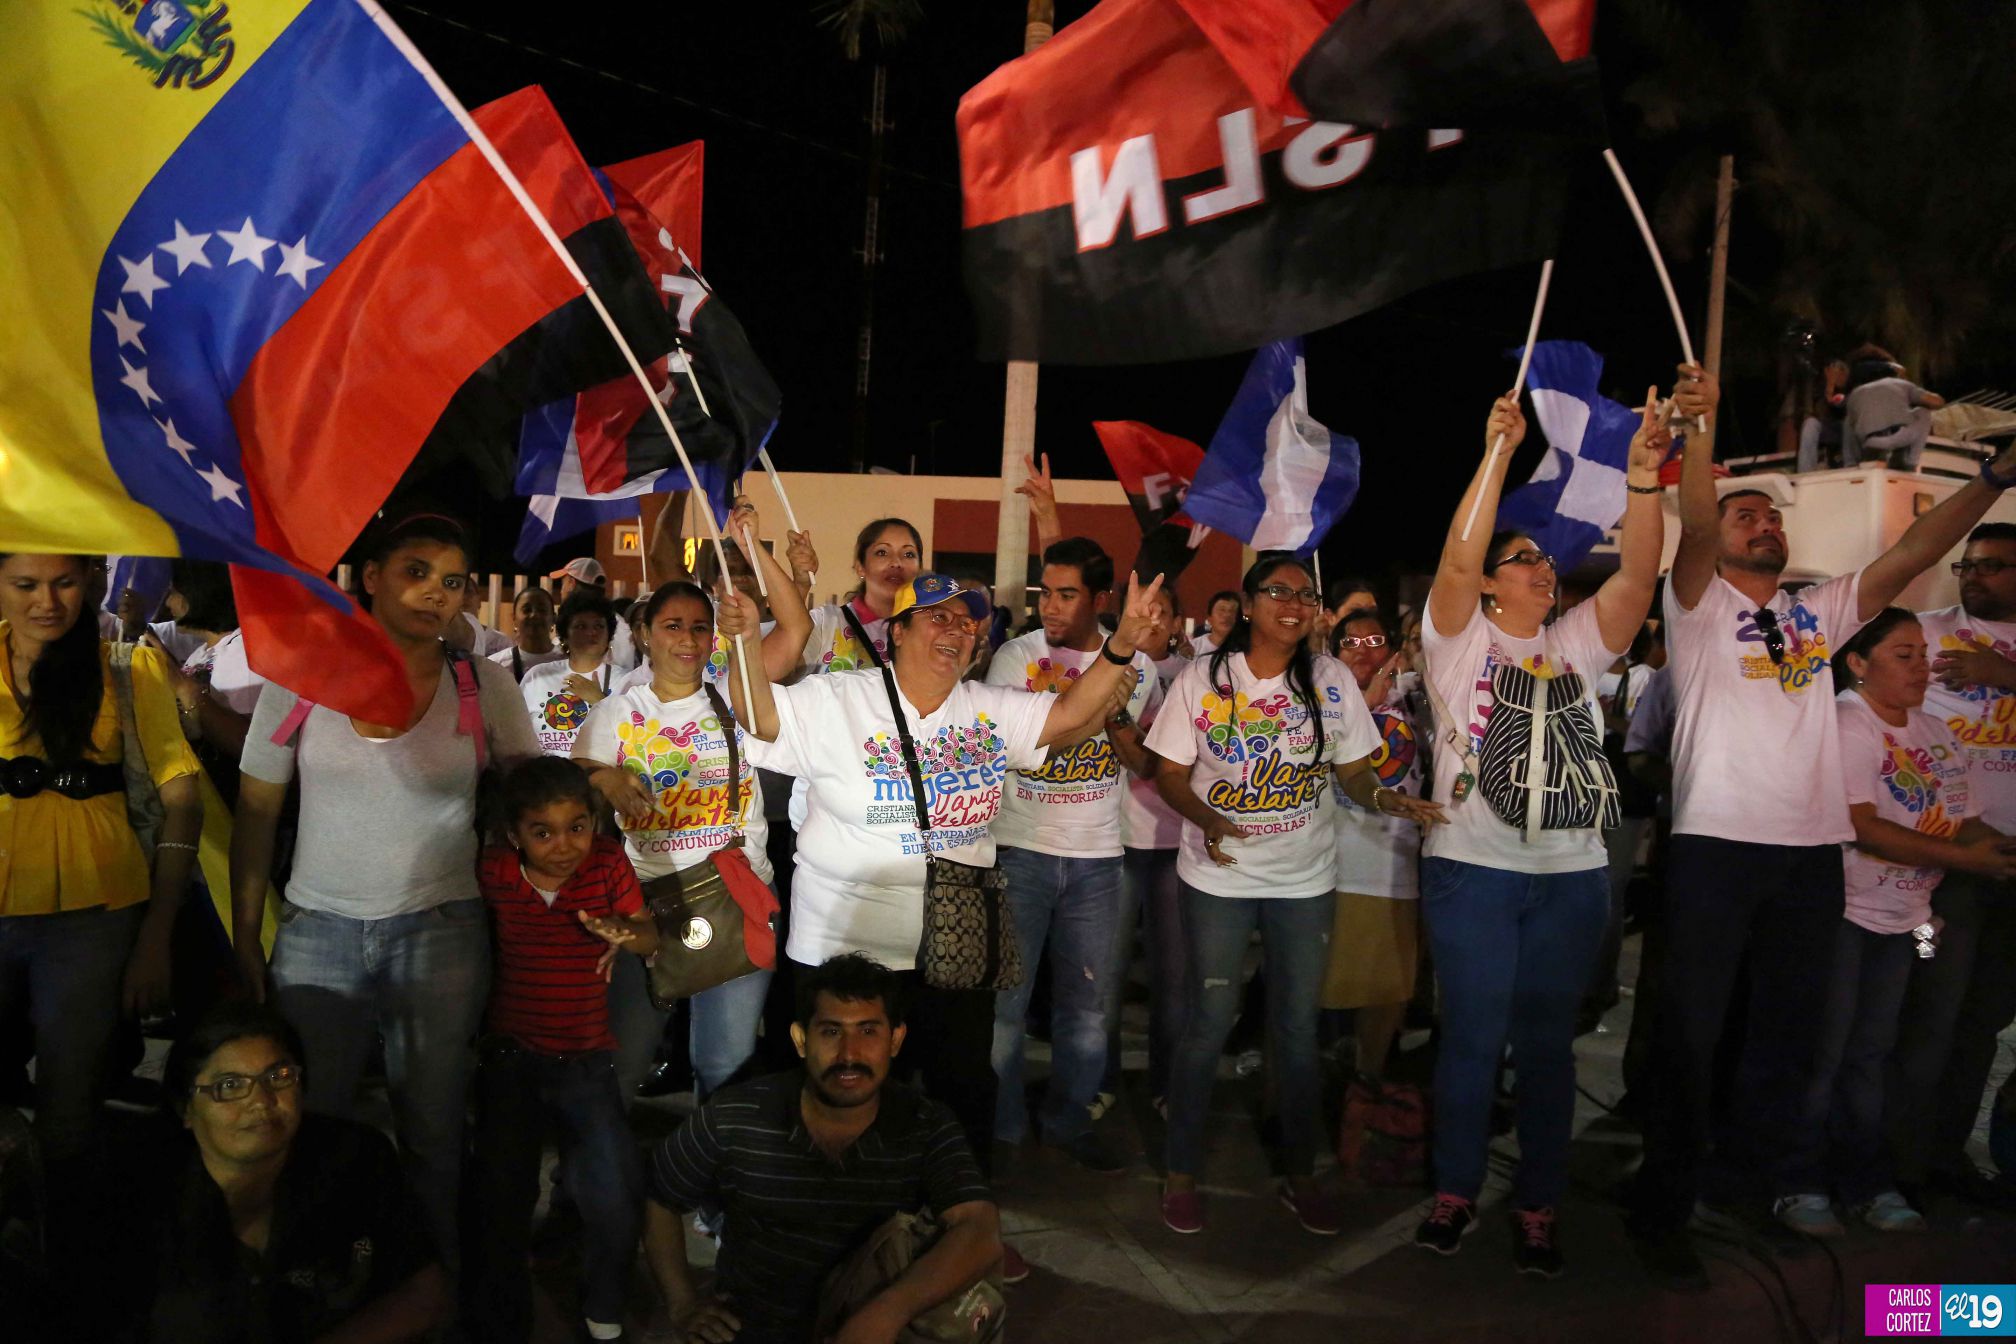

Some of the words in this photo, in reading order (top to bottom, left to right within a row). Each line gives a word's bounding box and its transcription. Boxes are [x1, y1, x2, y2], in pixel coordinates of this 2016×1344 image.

[692, 733, 708, 743] EN
[1016, 787, 1033, 801] EN
[1037, 787, 1111, 804] VICTORIAS!
[867, 804, 916, 812] CRISTIANA
[1282, 806, 1313, 820] SOLIDARIA
[867, 811, 917, 819] SOCIALIST
[900, 832, 916, 842] EN
[902, 842, 945, 855] BUENA
